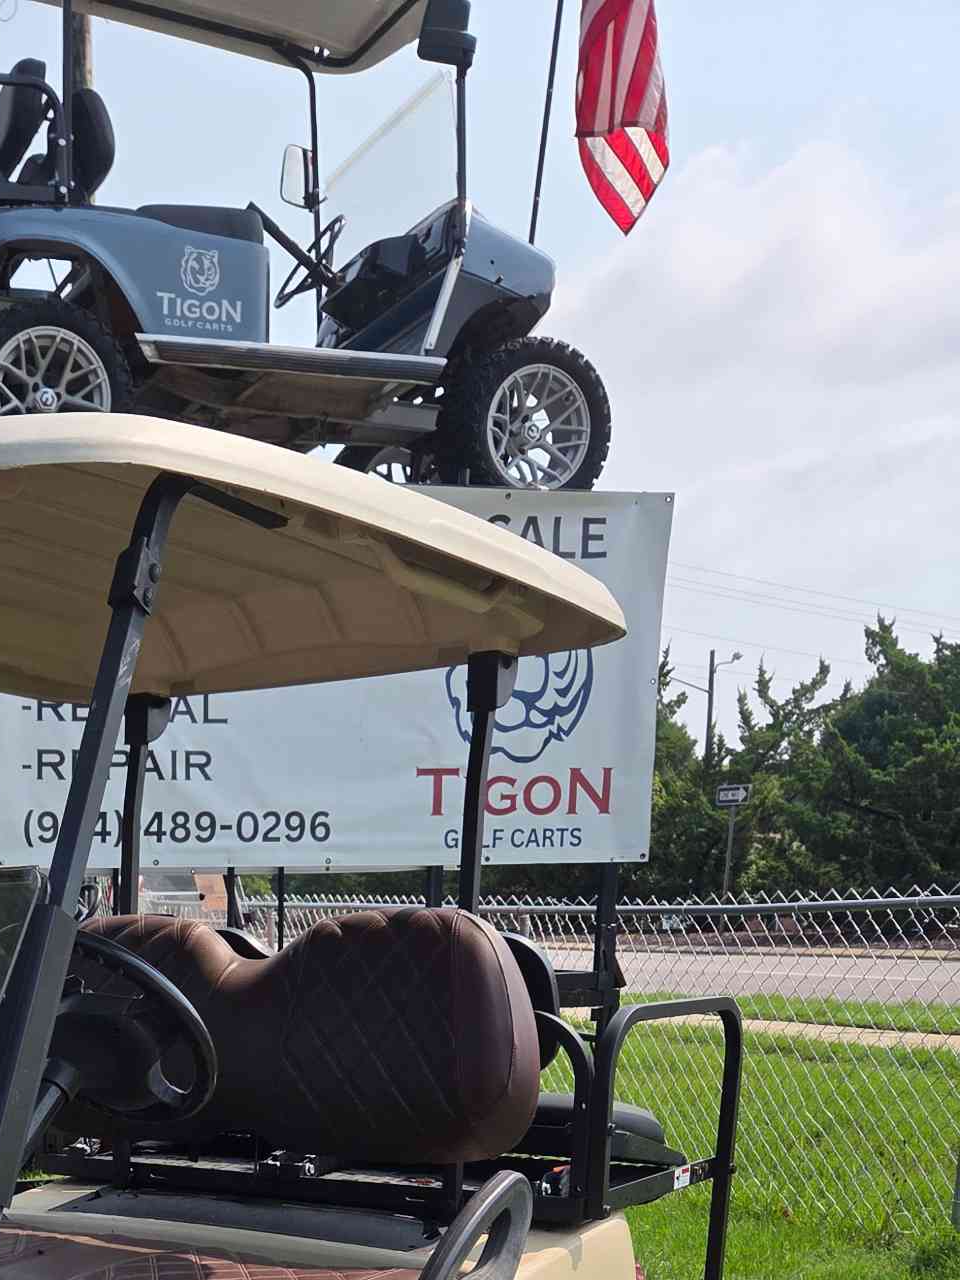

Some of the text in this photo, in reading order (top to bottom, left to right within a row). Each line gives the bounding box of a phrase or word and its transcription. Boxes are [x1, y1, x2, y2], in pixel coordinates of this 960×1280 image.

[156, 291, 242, 323] TIGON
[164, 317, 233, 332] GOLF CARTS
[22, 749, 213, 781] -RPAIR
[416, 767, 613, 816] TGON
[23, 809, 331, 847] (94) 489-0296
[510, 827, 583, 848] CARTS
